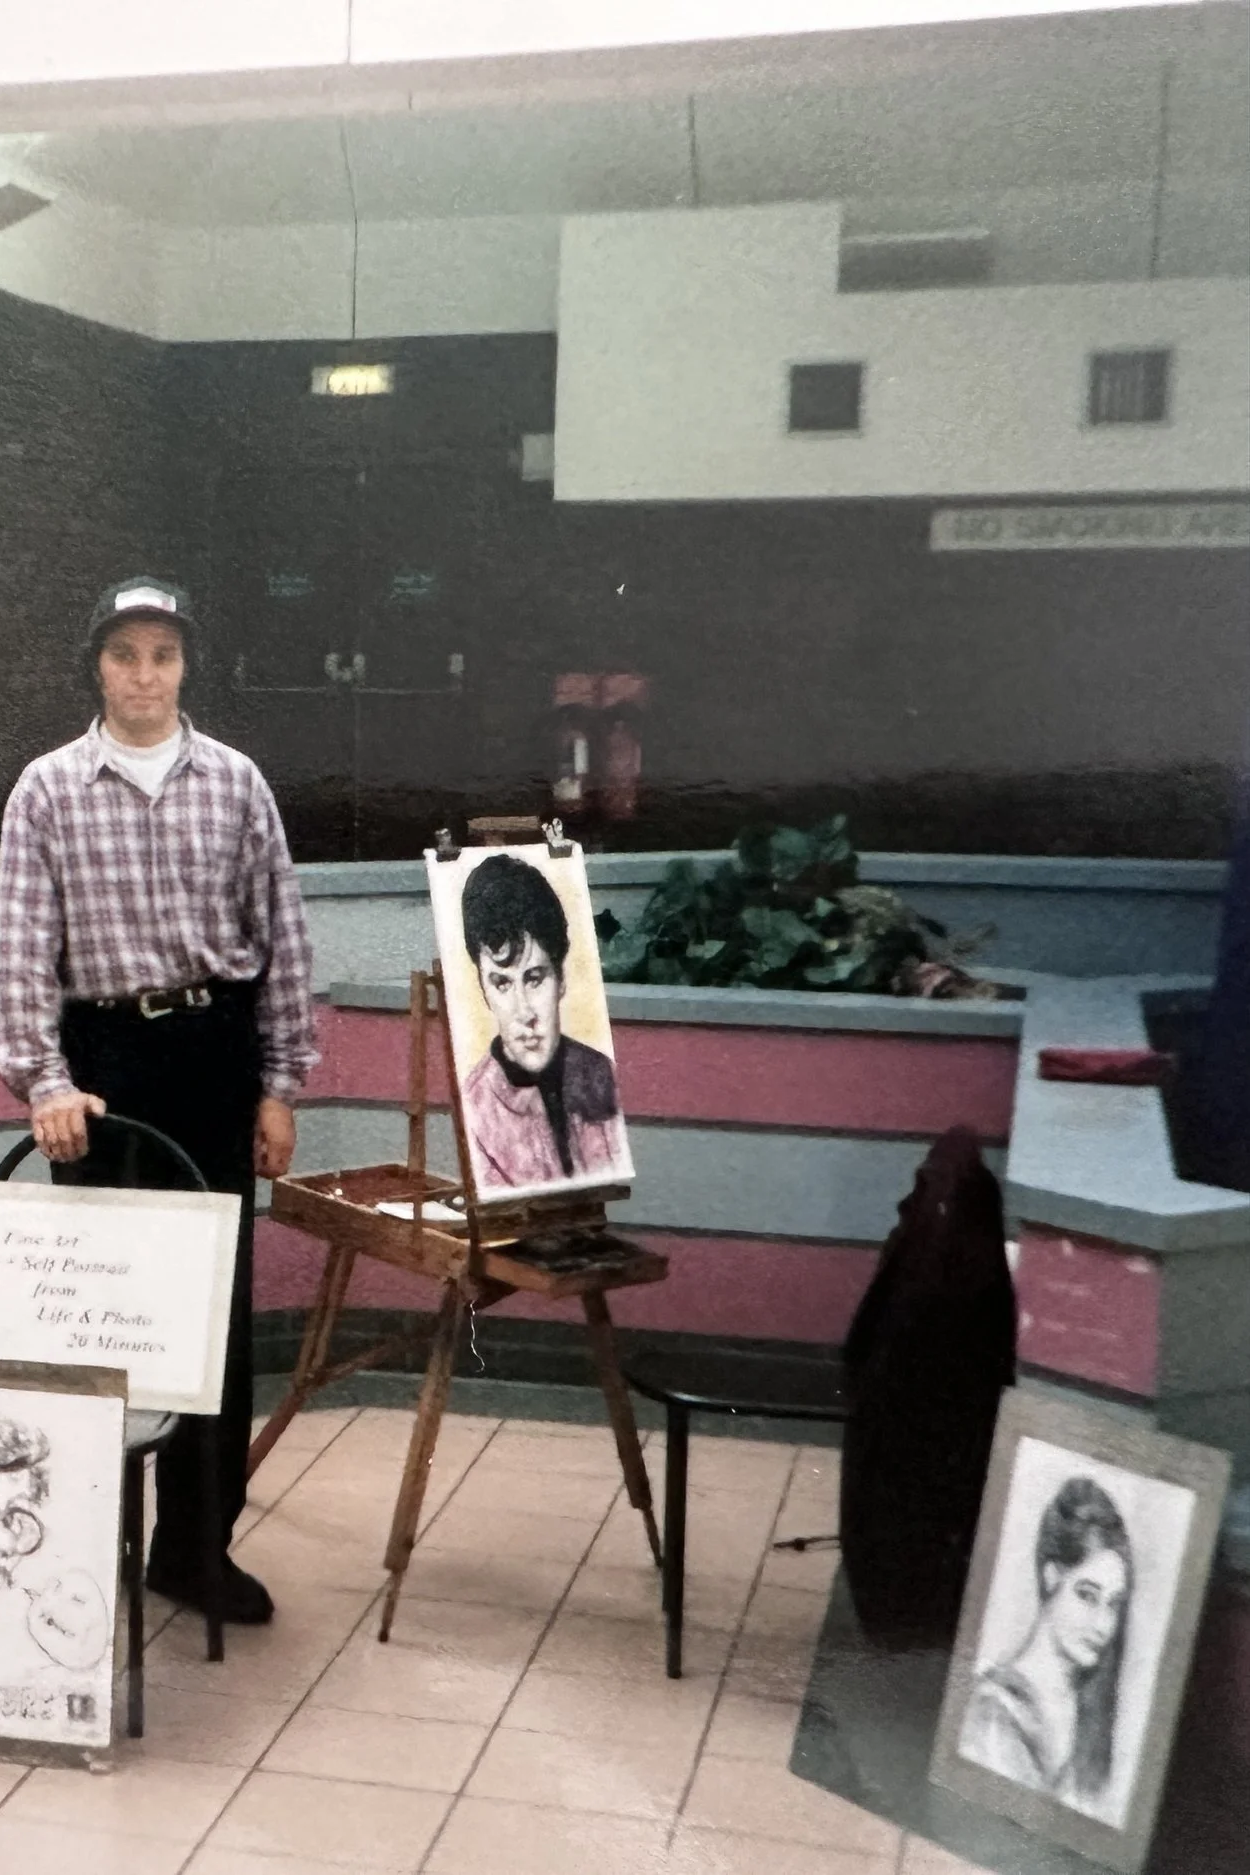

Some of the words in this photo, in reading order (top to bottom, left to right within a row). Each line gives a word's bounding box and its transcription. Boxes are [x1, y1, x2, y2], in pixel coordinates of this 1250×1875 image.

[32, 1280, 78, 1299] from
[36, 1304, 74, 1325] Life
[78, 1308, 93, 1325] &
[101, 1310, 153, 1327] Photo
[66, 1331, 88, 1349] 20
[97, 1335, 167, 1353] Minutes
